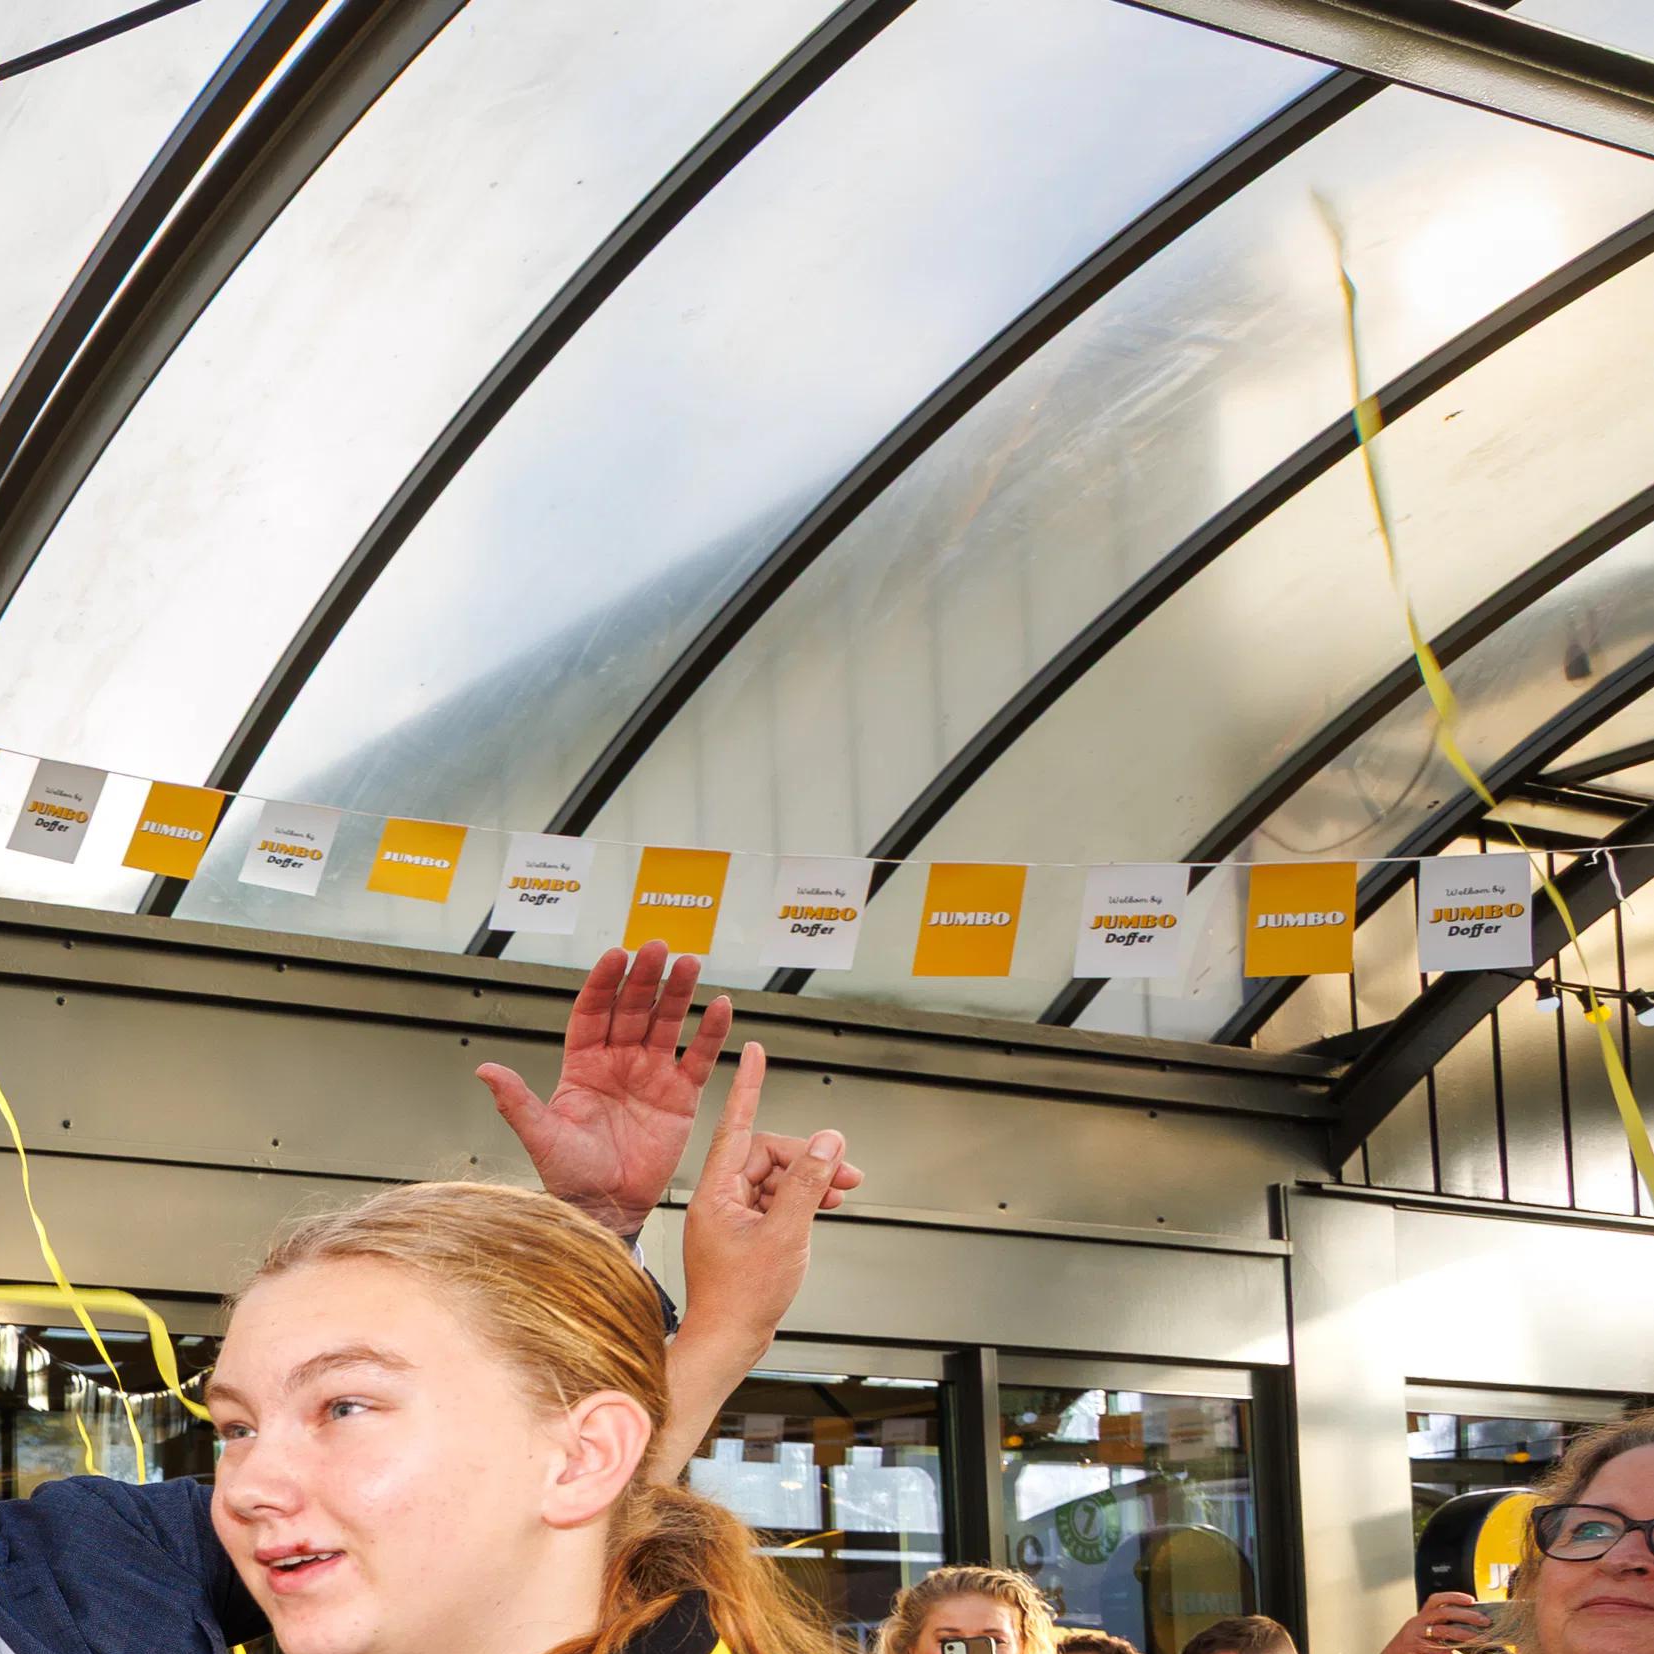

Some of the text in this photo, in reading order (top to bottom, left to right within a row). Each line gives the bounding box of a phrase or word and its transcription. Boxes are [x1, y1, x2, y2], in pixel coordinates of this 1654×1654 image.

[27, 800, 88, 823] JUMBO
[35, 817, 70, 834] Doffer
[140, 820, 203, 841] JUMBO
[257, 840, 323, 861] JUMBO
[267, 855, 303, 869] Doffer
[382, 851, 450, 868] JUMBO
[508, 876, 581, 893] JUMBO
[797, 886, 833, 897] Welkom
[1446, 884, 1506, 898] Welkom bij
[519, 892, 560, 906] Doffer
[638, 892, 713, 908] JUMBO
[1108, 896, 1147, 905] Welkom
[777, 905, 856, 921] JUMBO
[928, 911, 1010, 926] JUMBO
[1255, 911, 1345, 928] JUMBO
[1429, 903, 1524, 924] JUMBO
[790, 922, 835, 938] Doffer
[1089, 914, 1177, 930] JUMBO
[1447, 922, 1502, 939] Doffer
[1104, 932, 1154, 947] Doffer
